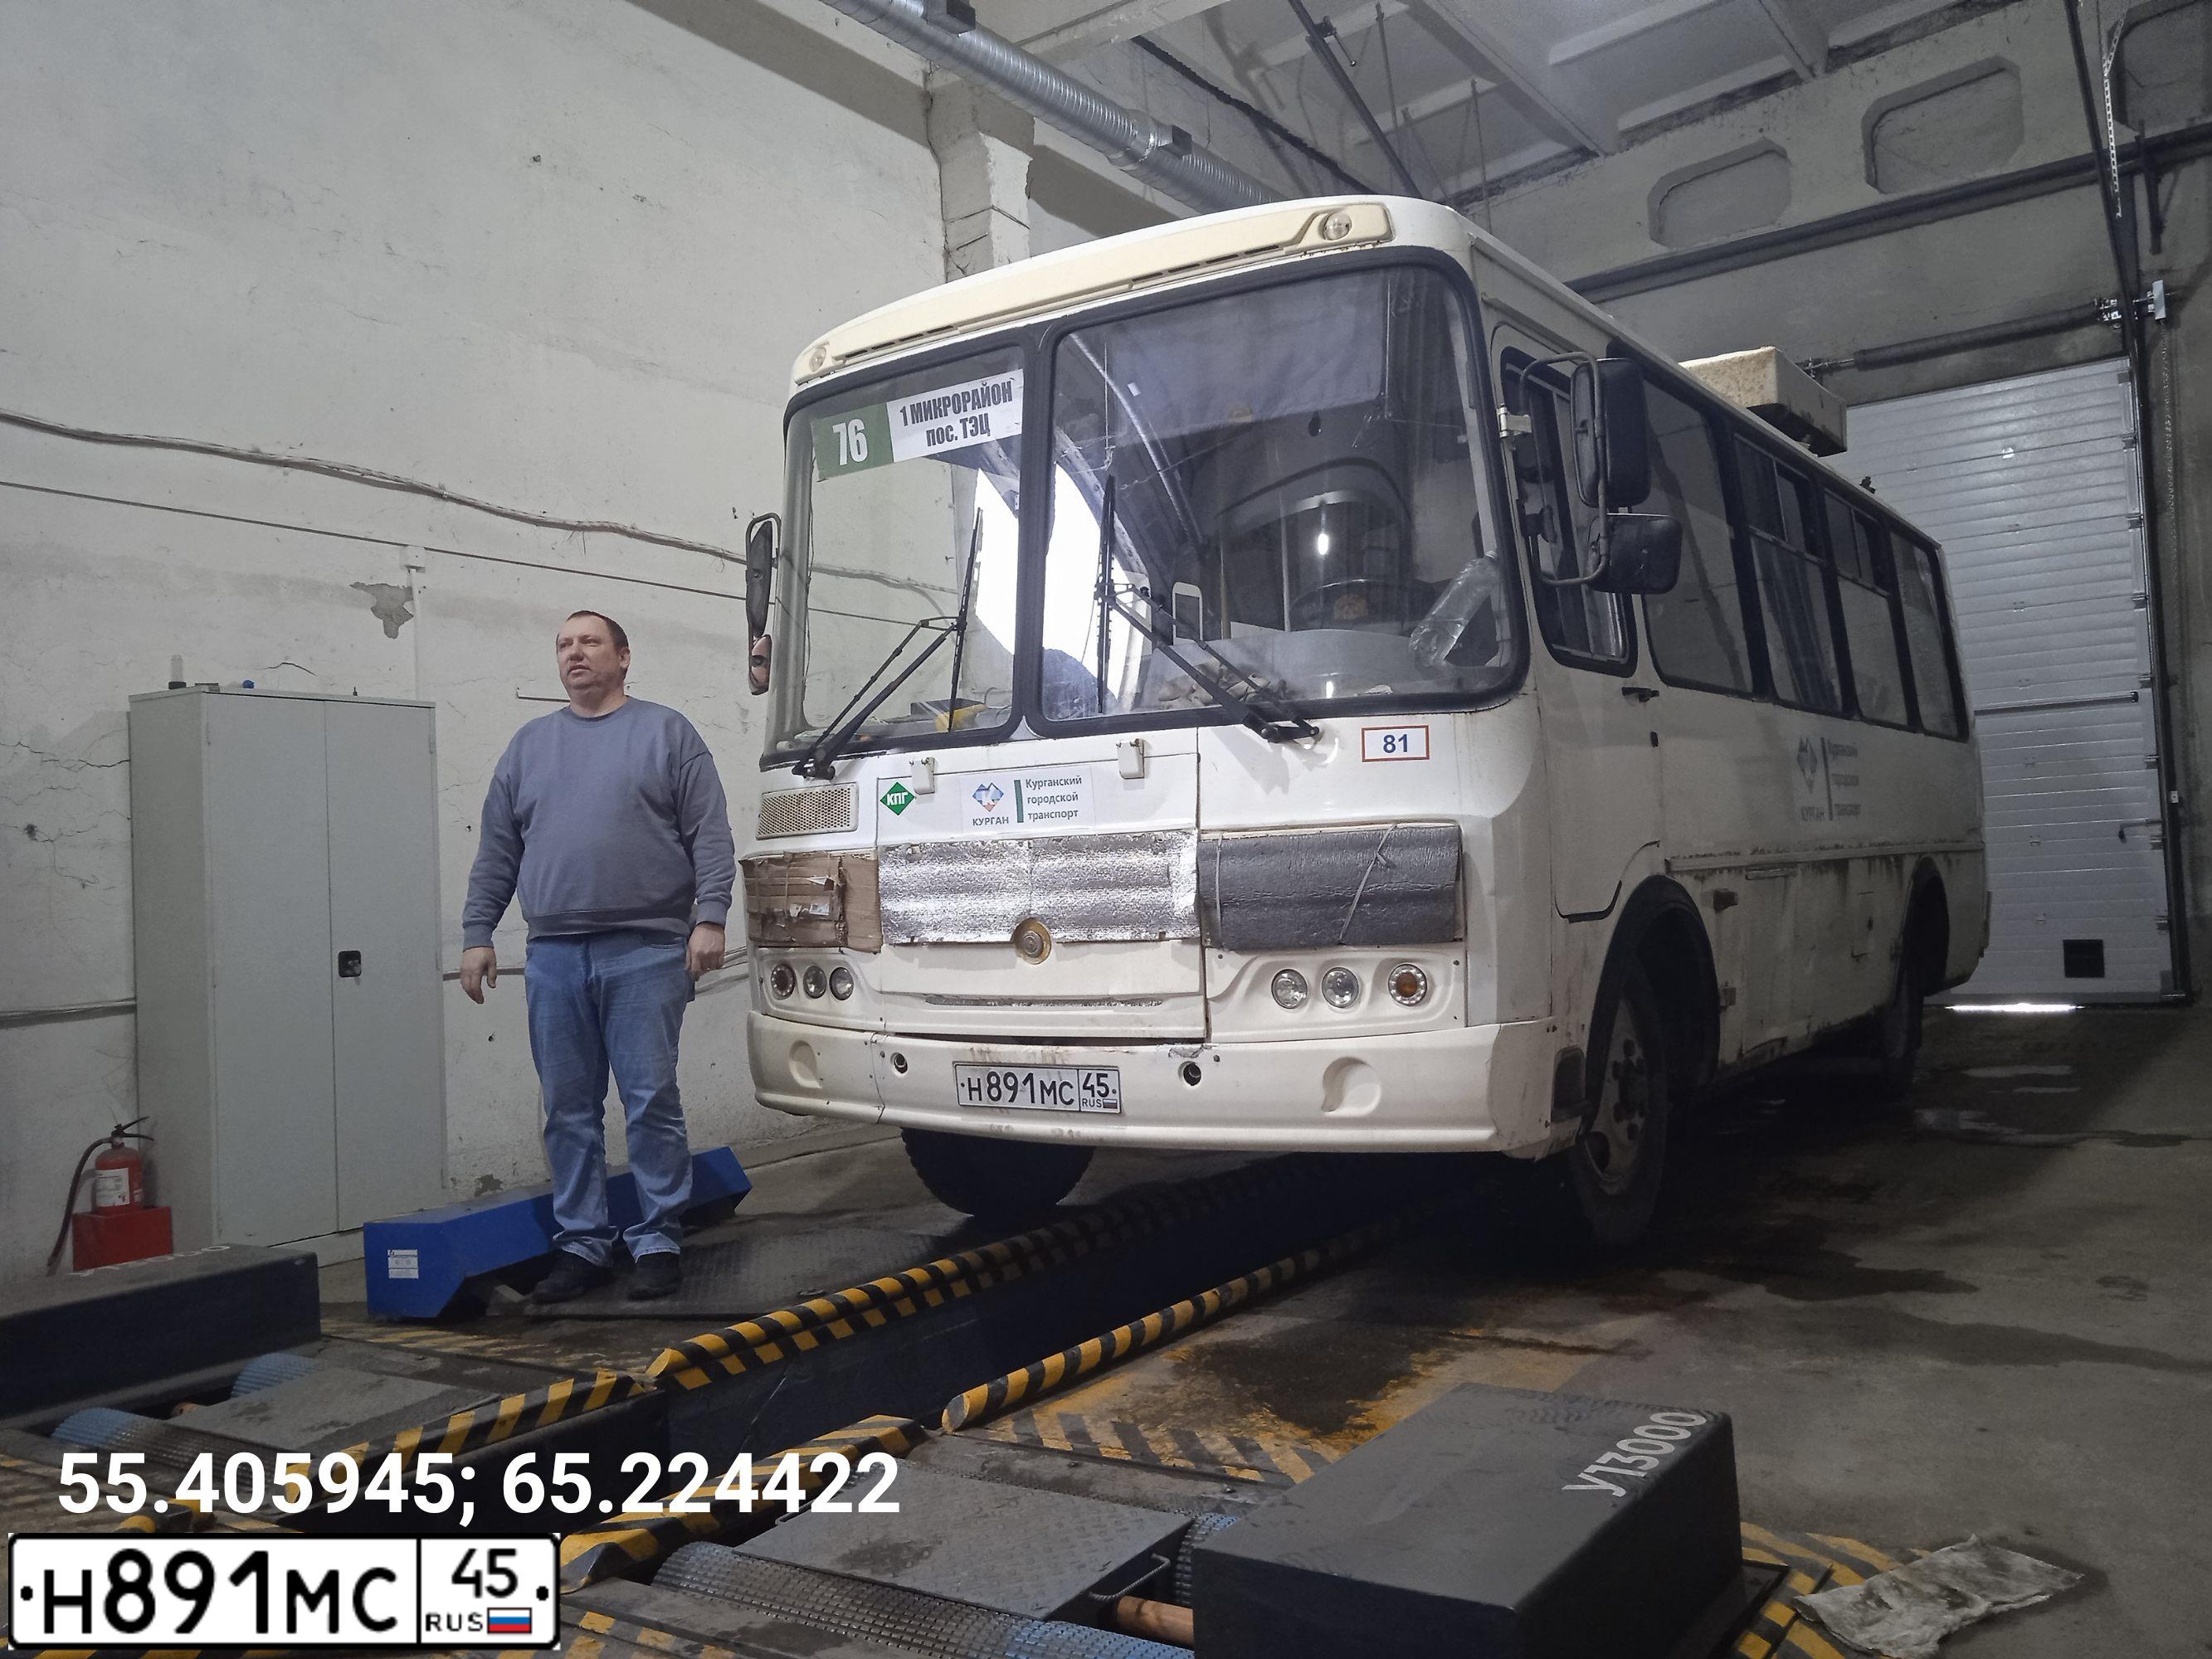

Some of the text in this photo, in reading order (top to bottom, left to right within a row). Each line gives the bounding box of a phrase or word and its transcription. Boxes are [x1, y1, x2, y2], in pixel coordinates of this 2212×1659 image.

[899, 381, 1013, 426] 1 МИКРОРАЙОН
[959, 412, 991, 439] ТЭЦ
[832, 418, 869, 465] 76
[1382, 733, 1408, 753] 81
[1025, 775, 1082, 790] Курганский
[886, 791, 909, 806] КПГ
[1027, 792, 1079, 807] городской
[972, 815, 1009, 826] КУРГАН
[1027, 808, 1079, 822] транспорт
[967, 1071, 1110, 1105] Н891МС 45
[1082, 1098, 1102, 1108] RUS
